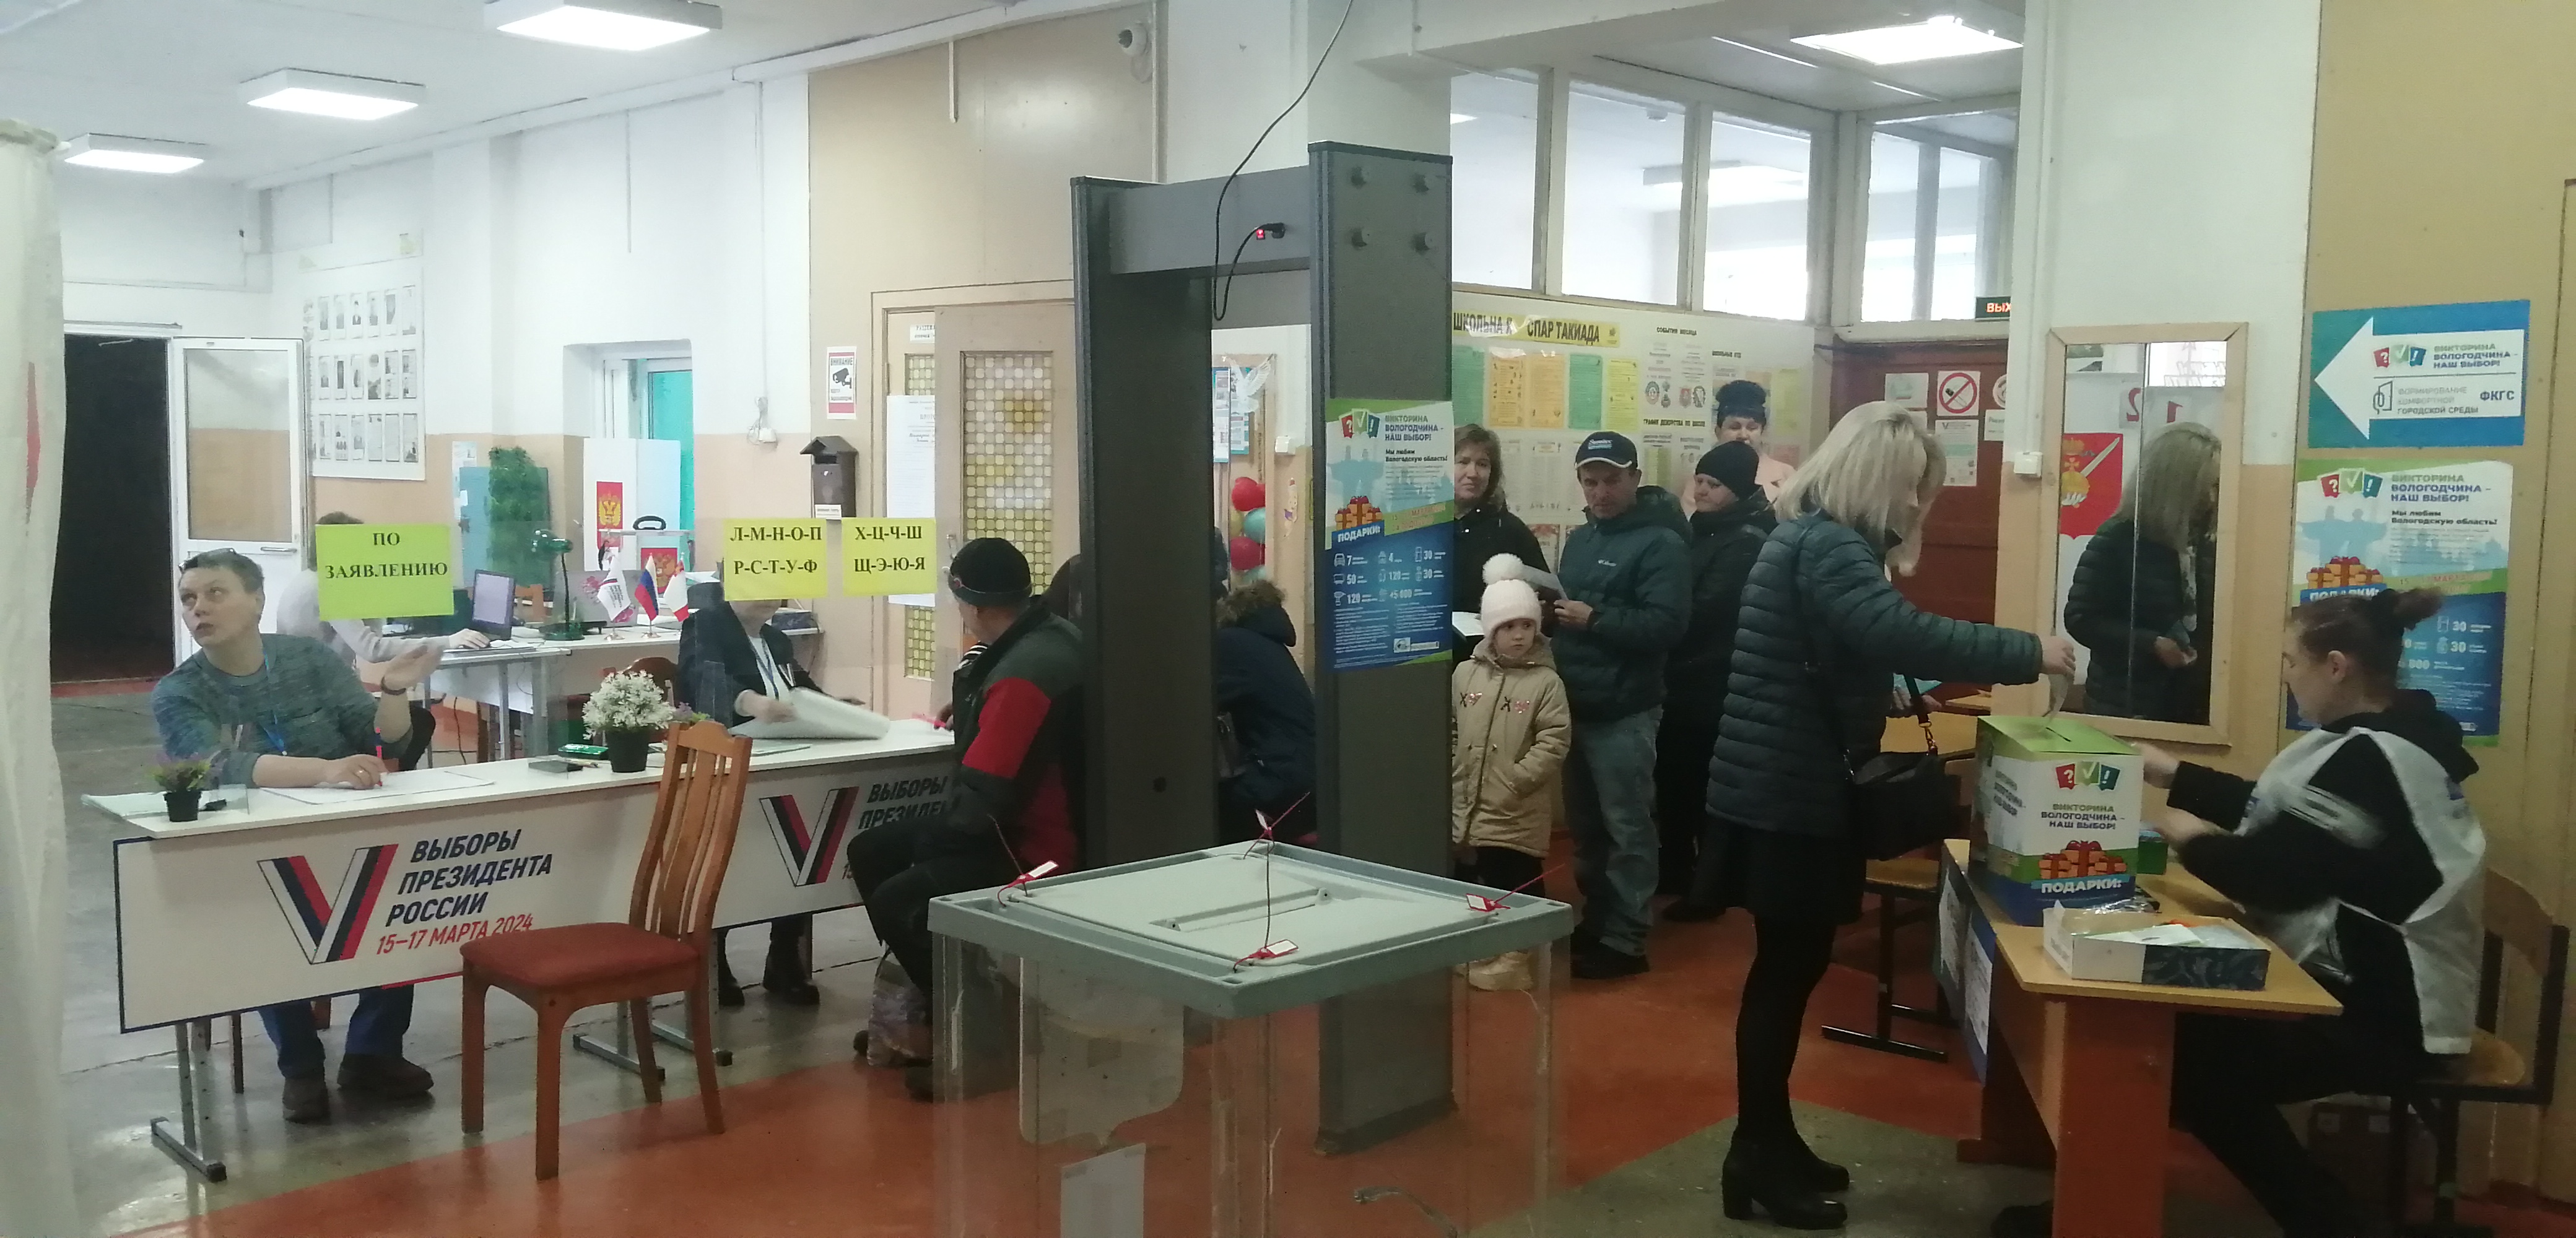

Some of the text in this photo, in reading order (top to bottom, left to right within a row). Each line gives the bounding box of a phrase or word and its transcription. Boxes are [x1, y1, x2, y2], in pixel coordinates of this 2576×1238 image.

[2434, 351, 2511, 361] ВОЛОГОДЧИНА
[2434, 360, 2500, 369] НАШ ВЫБОР!
[2479, 390, 2515, 402] ФКГС
[2398, 405, 2479, 415] ГОРОДСКОЙ СРЕДЫ
[1385, 424, 1438, 432] ВОЛОГОДЧИНА
[2391, 484, 2481, 493] ВОЛОГОДЧИНА
[2422, 494, 2469, 502] ВЫБОР!
[2391, 517, 2454, 526] Вологодскую
[373, 532, 400, 546] ПО
[729, 526, 822, 542] Л-М-Н-О-П
[855, 526, 923, 542] Х-Ц-Ч-Ш
[1338, 526, 1381, 543] ПОДАРКИ:
[1424, 550, 1432, 560] 30
[324, 562, 448, 579] ЗАЯВЛЕНИЮ
[734, 559, 818, 575] Р-С-Т-У-Ф
[854, 556, 926, 574] Щ-Э-Ю-Я
[1346, 574, 1356, 584] 50
[1424, 569, 1432, 579] 30
[1347, 592, 1360, 604] 120
[2453, 621, 2466, 632] 30
[2450, 641, 2466, 652] 30
[866, 776, 949, 803] ВЫБОРЫ
[2053, 803, 2114, 812] ВИКТОРИНА
[2041, 812, 2117, 821] ВОЛОГОДЧИНА
[2076, 821, 2115, 830] ВЫБОР!
[411, 829, 522, 864] ВЫБОРЫ
[397, 854, 553, 895] ПРЕЗИДЕНТА
[2041, 879, 2122, 894] ПОДАРКИ:
[385, 892, 489, 927] РОССИИ
[429, 920, 489, 948] МАРТА
[492, 913, 534, 935] 2024
